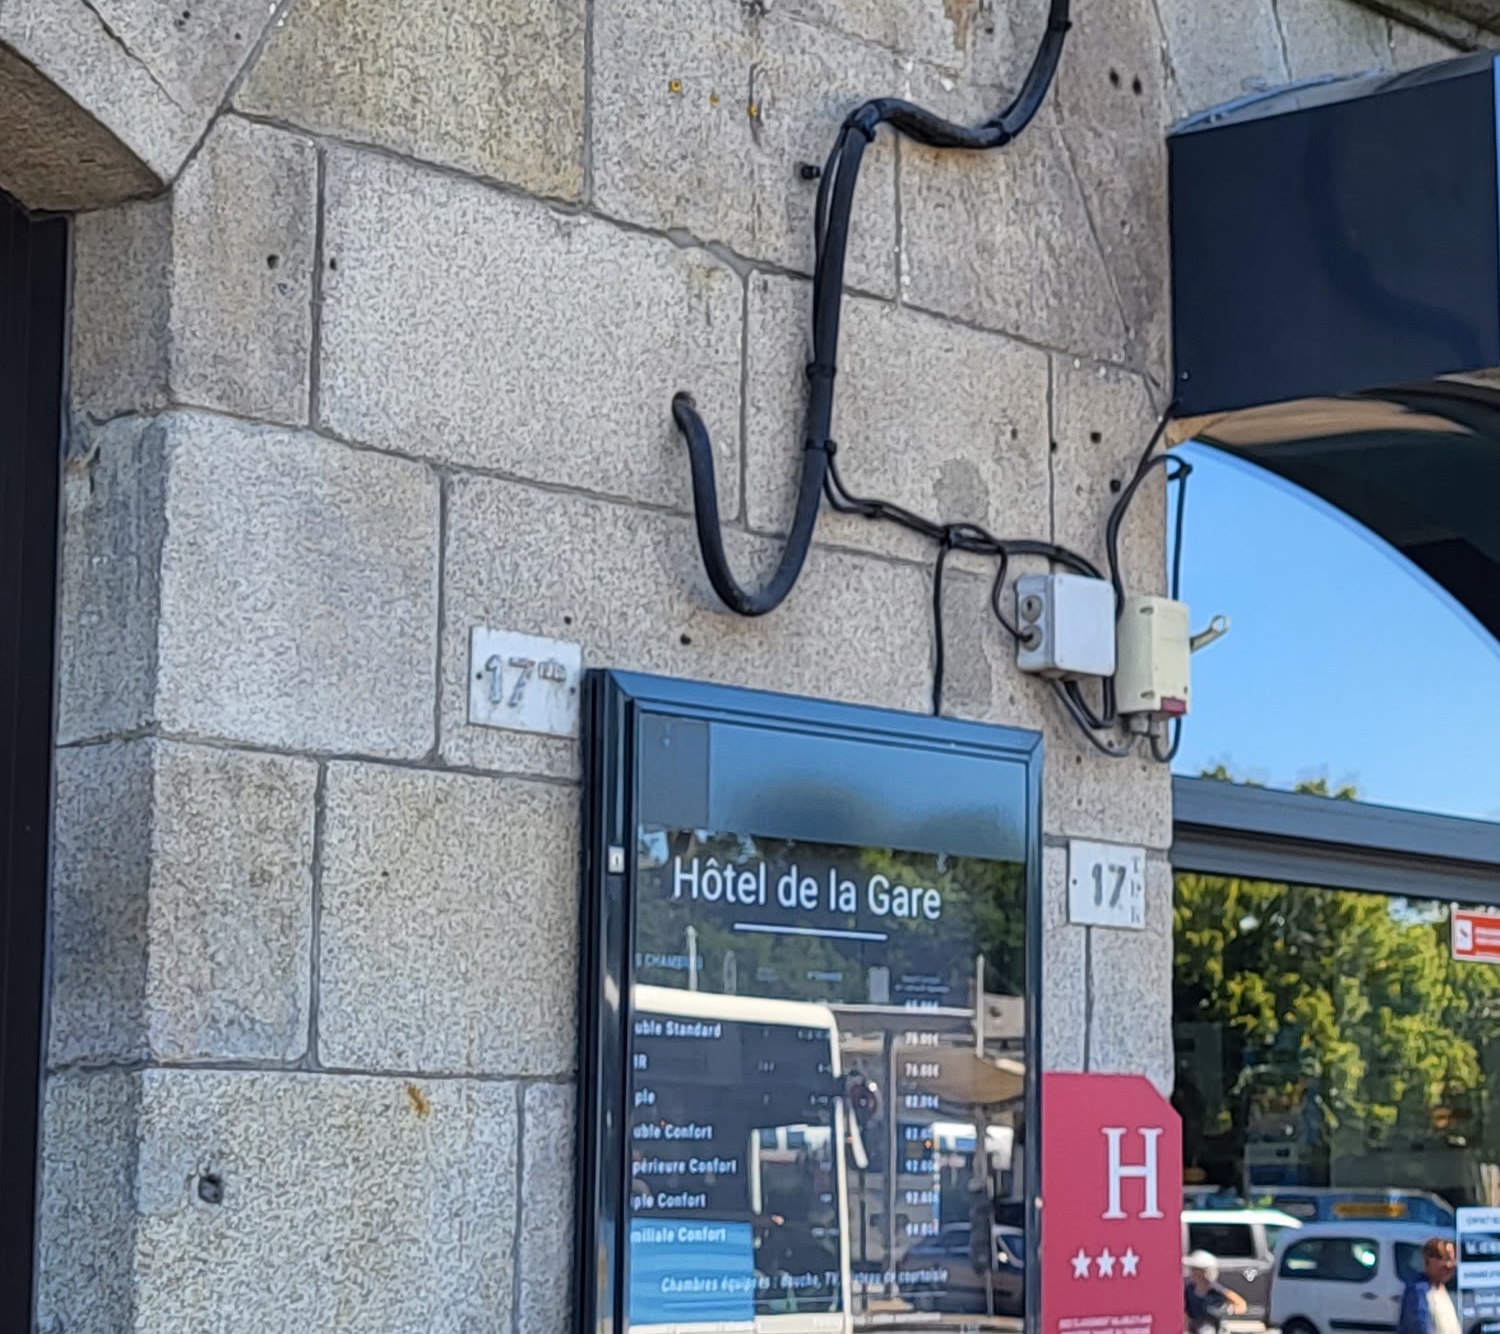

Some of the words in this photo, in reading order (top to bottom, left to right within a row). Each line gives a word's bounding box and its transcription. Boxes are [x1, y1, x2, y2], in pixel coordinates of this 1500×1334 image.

[672, 856, 765, 906] Hôtel
[777, 865, 818, 910] de
[829, 868, 857, 913] la
[867, 874, 942, 919] Gare
[1091, 863, 1127, 908] 17
[666, 1020, 722, 1038] Standard
[664, 1123, 713, 1140] Confort
[688, 1158, 737, 1174] Confort
[1101, 1126, 1164, 1220] H
[657, 1192, 707, 1208] Confort
